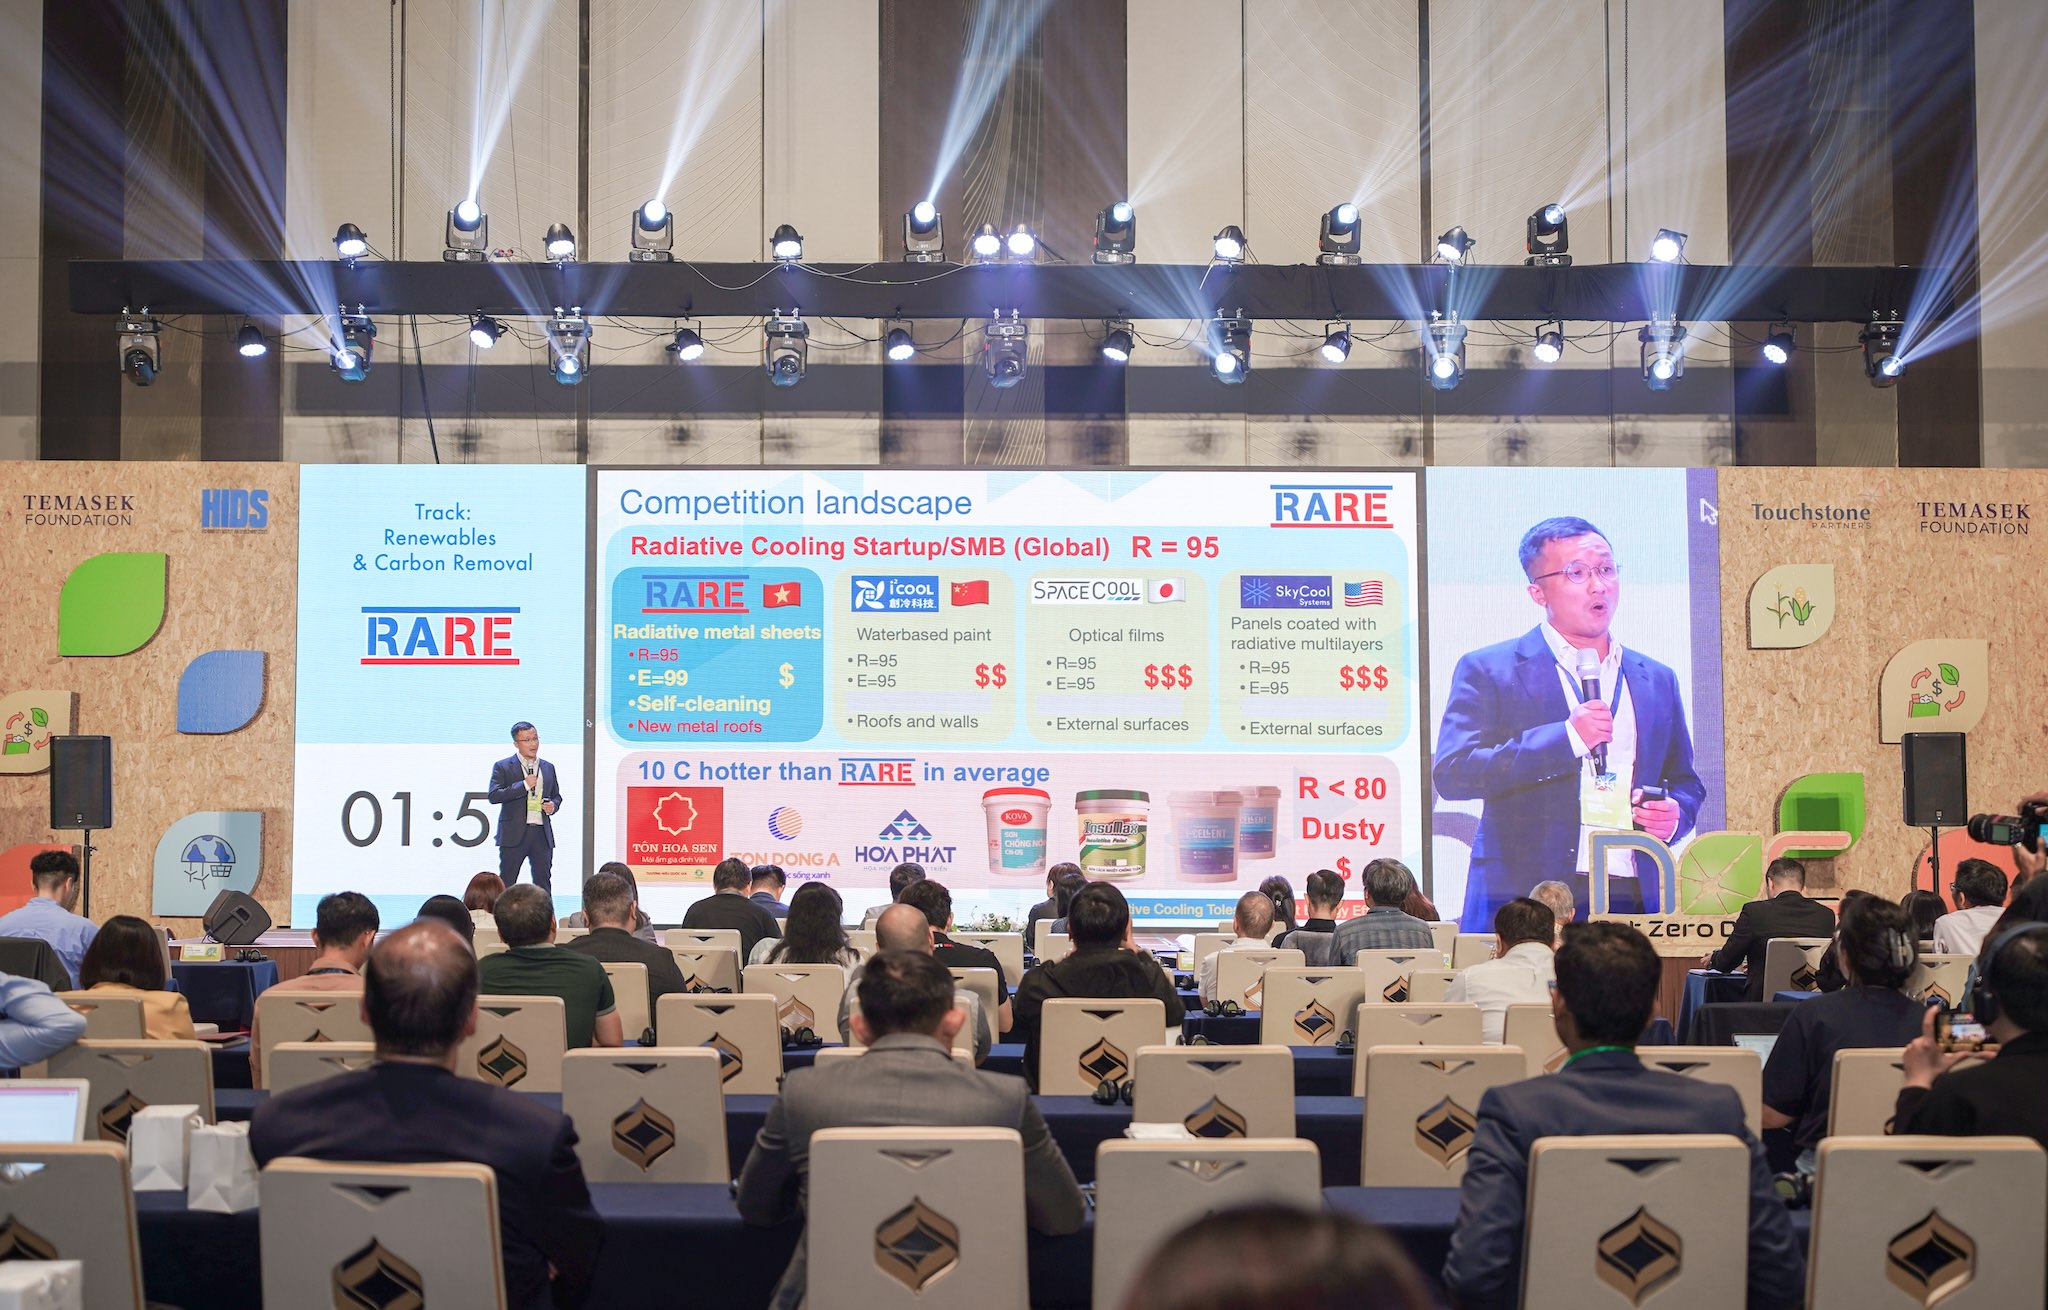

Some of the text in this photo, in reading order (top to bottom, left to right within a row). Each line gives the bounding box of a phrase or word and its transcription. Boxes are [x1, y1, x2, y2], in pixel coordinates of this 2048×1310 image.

[23, 494, 135, 512] TEMASEK
[202, 489, 268, 528] HIDS
[620, 489, 972, 520] Competition landscape
[1275, 492, 1388, 522] RARE
[1752, 503, 1870, 520] Touchstone
[1917, 502, 2031, 520] TEMASEK
[25, 514, 132, 526] FOUNDATION
[414, 503, 471, 521] Track:
[1920, 522, 2028, 534] FOUNDATION
[384, 528, 496, 546] Renewables
[630, 536, 1110, 562] Radiative Cooling Startup/SMB (Global)
[1132, 536, 1220, 558] R = 95
[353, 553, 533, 572] & Carbon Removal
[646, 580, 744, 608] RARE
[1276, 584, 1330, 600] SkyCool
[1299, 598, 1330, 608] Systems
[614, 624, 822, 640] Radiative metal sheets
[1232, 616, 1376, 631] Panels coated with
[368, 616, 512, 656] RARE
[857, 627, 992, 644] Waterbased paint
[1068, 628, 1164, 644] Optical films
[1231, 637, 1384, 654] radiative multilayers
[638, 648, 679, 662] R=95
[857, 654, 898, 667] R=95
[1056, 656, 1096, 670] R=95
[778, 662, 795, 689] $
[974, 662, 1008, 689] $$
[1249, 660, 1290, 674] R=95
[638, 670, 688, 686] E=99
[857, 674, 897, 688] E=95
[1056, 676, 1096, 690] E=95
[1144, 662, 1194, 690] $$$
[1339, 664, 1389, 691] $$$
[1250, 681, 1290, 695] E=95
[638, 695, 771, 715] Self-cleaning
[638, 720, 762, 733] New metal roofs
[857, 714, 979, 728] Roofs and walls
[1056, 718, 1190, 731] External surfaces
[1250, 722, 1384, 736] External surfaces
[638, 760, 1050, 786] 10 C hotter than RARE in average
[1299, 776, 1386, 800] R < 80
[342, 790, 491, 848] 01:5
[1084, 820, 1138, 835] InsuMax
[1302, 817, 1385, 846] Dusty
[632, 840, 718, 854] TÔN HOA SEN
[856, 846, 956, 862] HÒA PHÁT
[1336, 856, 1352, 882] $
[1154, 904, 1204, 918] Cooling
[1648, 920, 1714, 938] Zero
